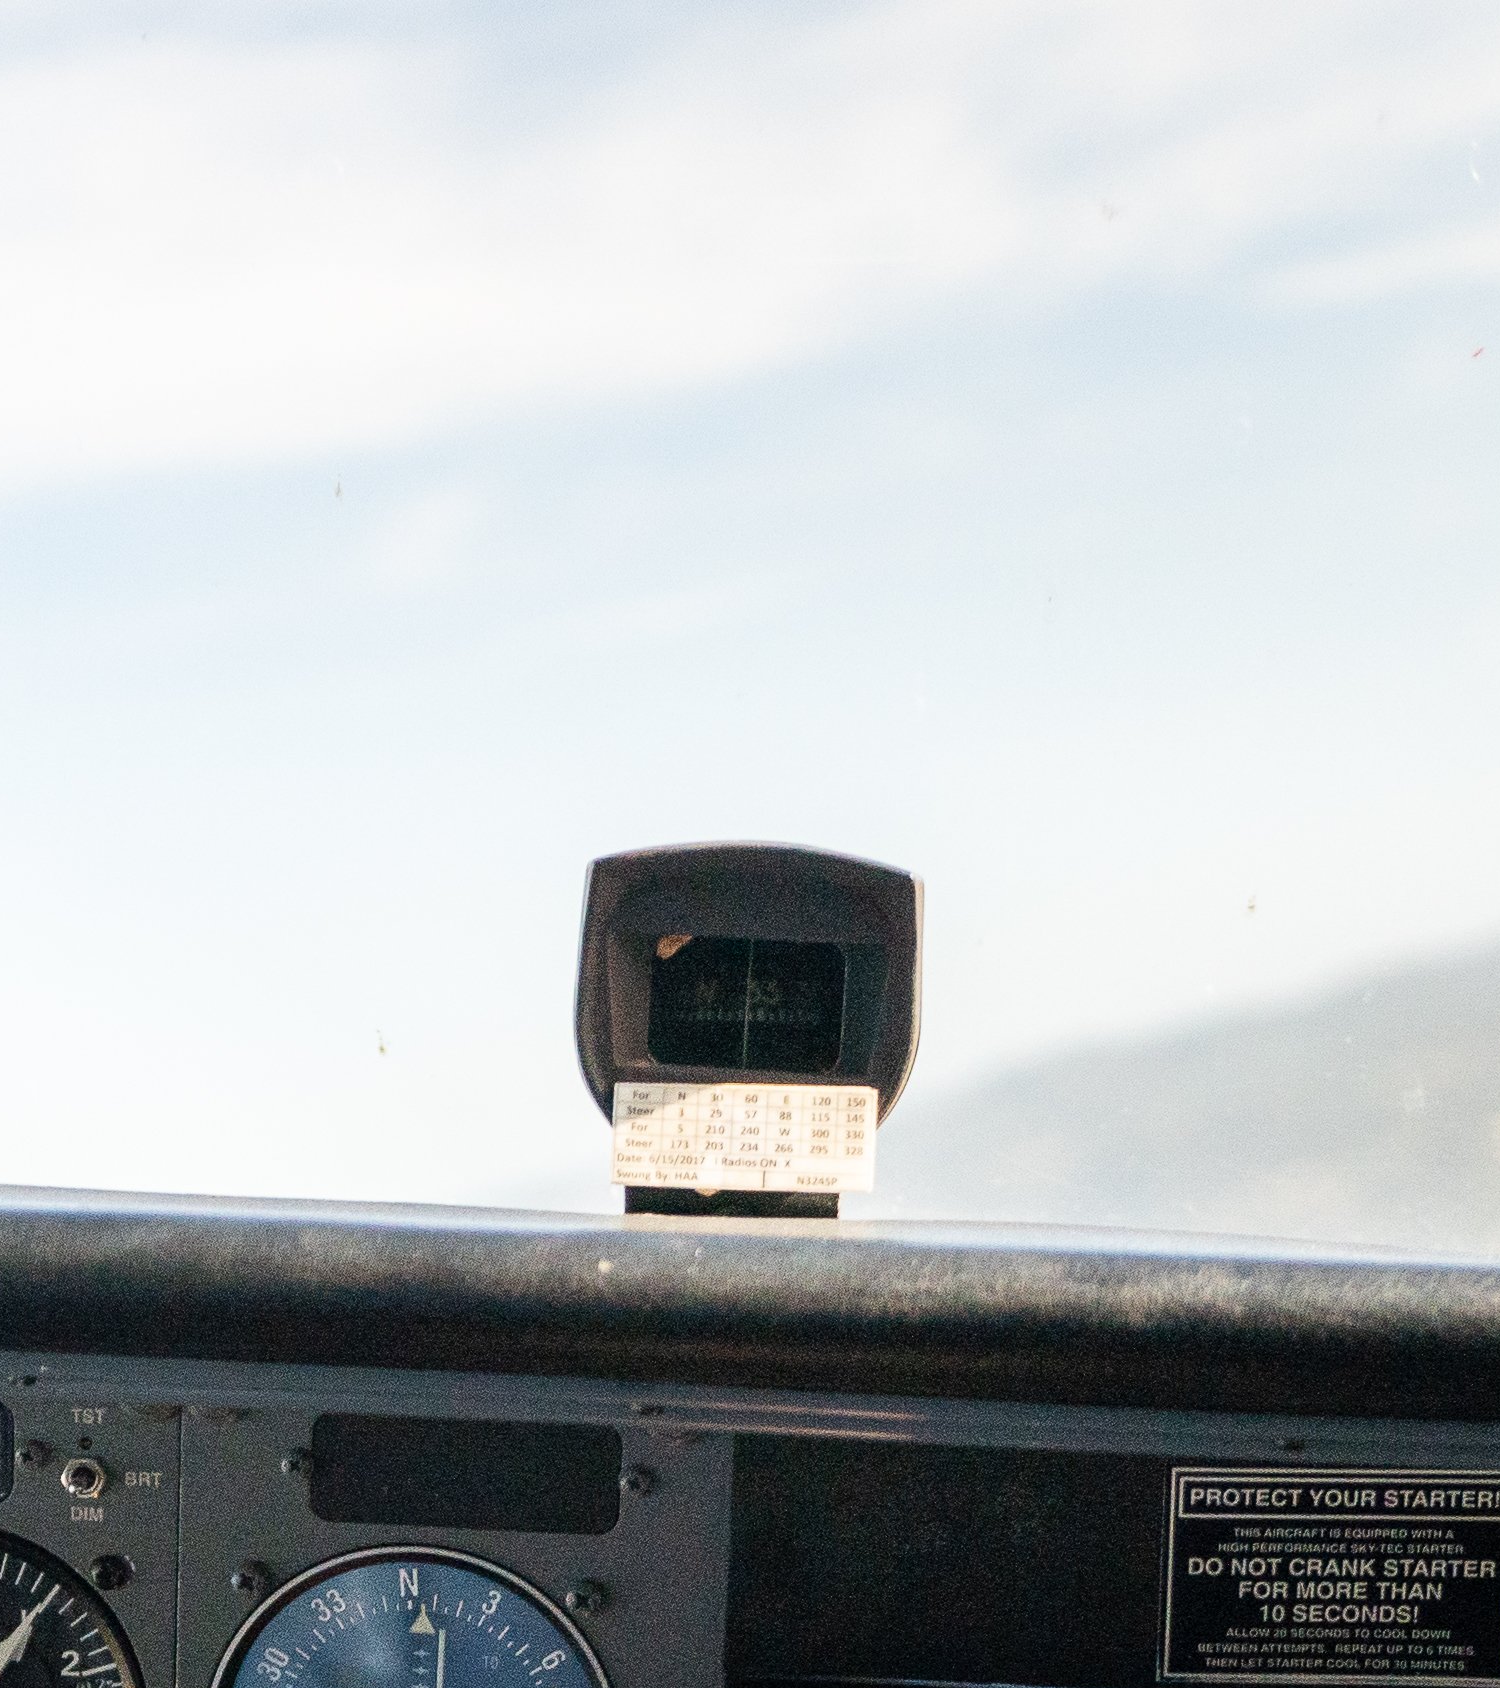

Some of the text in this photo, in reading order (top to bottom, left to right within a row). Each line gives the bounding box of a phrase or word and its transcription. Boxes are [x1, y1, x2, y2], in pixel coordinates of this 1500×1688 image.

[627, 1105, 655, 1115] Steer
[812, 1097, 831, 1107] 120
[847, 1098, 866, 1107] 150
[705, 1126, 760, 1136] 210 240
[71, 1408, 106, 1424] TST
[124, 1471, 162, 1487] BRT
[1190, 1487, 1500, 1510] PROTECT YOUR STARTER!
[70, 1506, 103, 1522] DIM
[1233, 1526, 1261, 1538] THIS
[1264, 1526, 1326, 1539] AIRCRAFT
[1344, 1528, 1408, 1540] EQUIPPED
[1187, 1557, 1497, 1579] DO NOT CRANK STARTER
[1238, 1581, 1443, 1602] FOR MORE THAN
[310, 1589, 346, 1622] 33
[1259, 1604, 1420, 1625] 10 SECONDS!
[258, 1647, 290, 1682] 30
